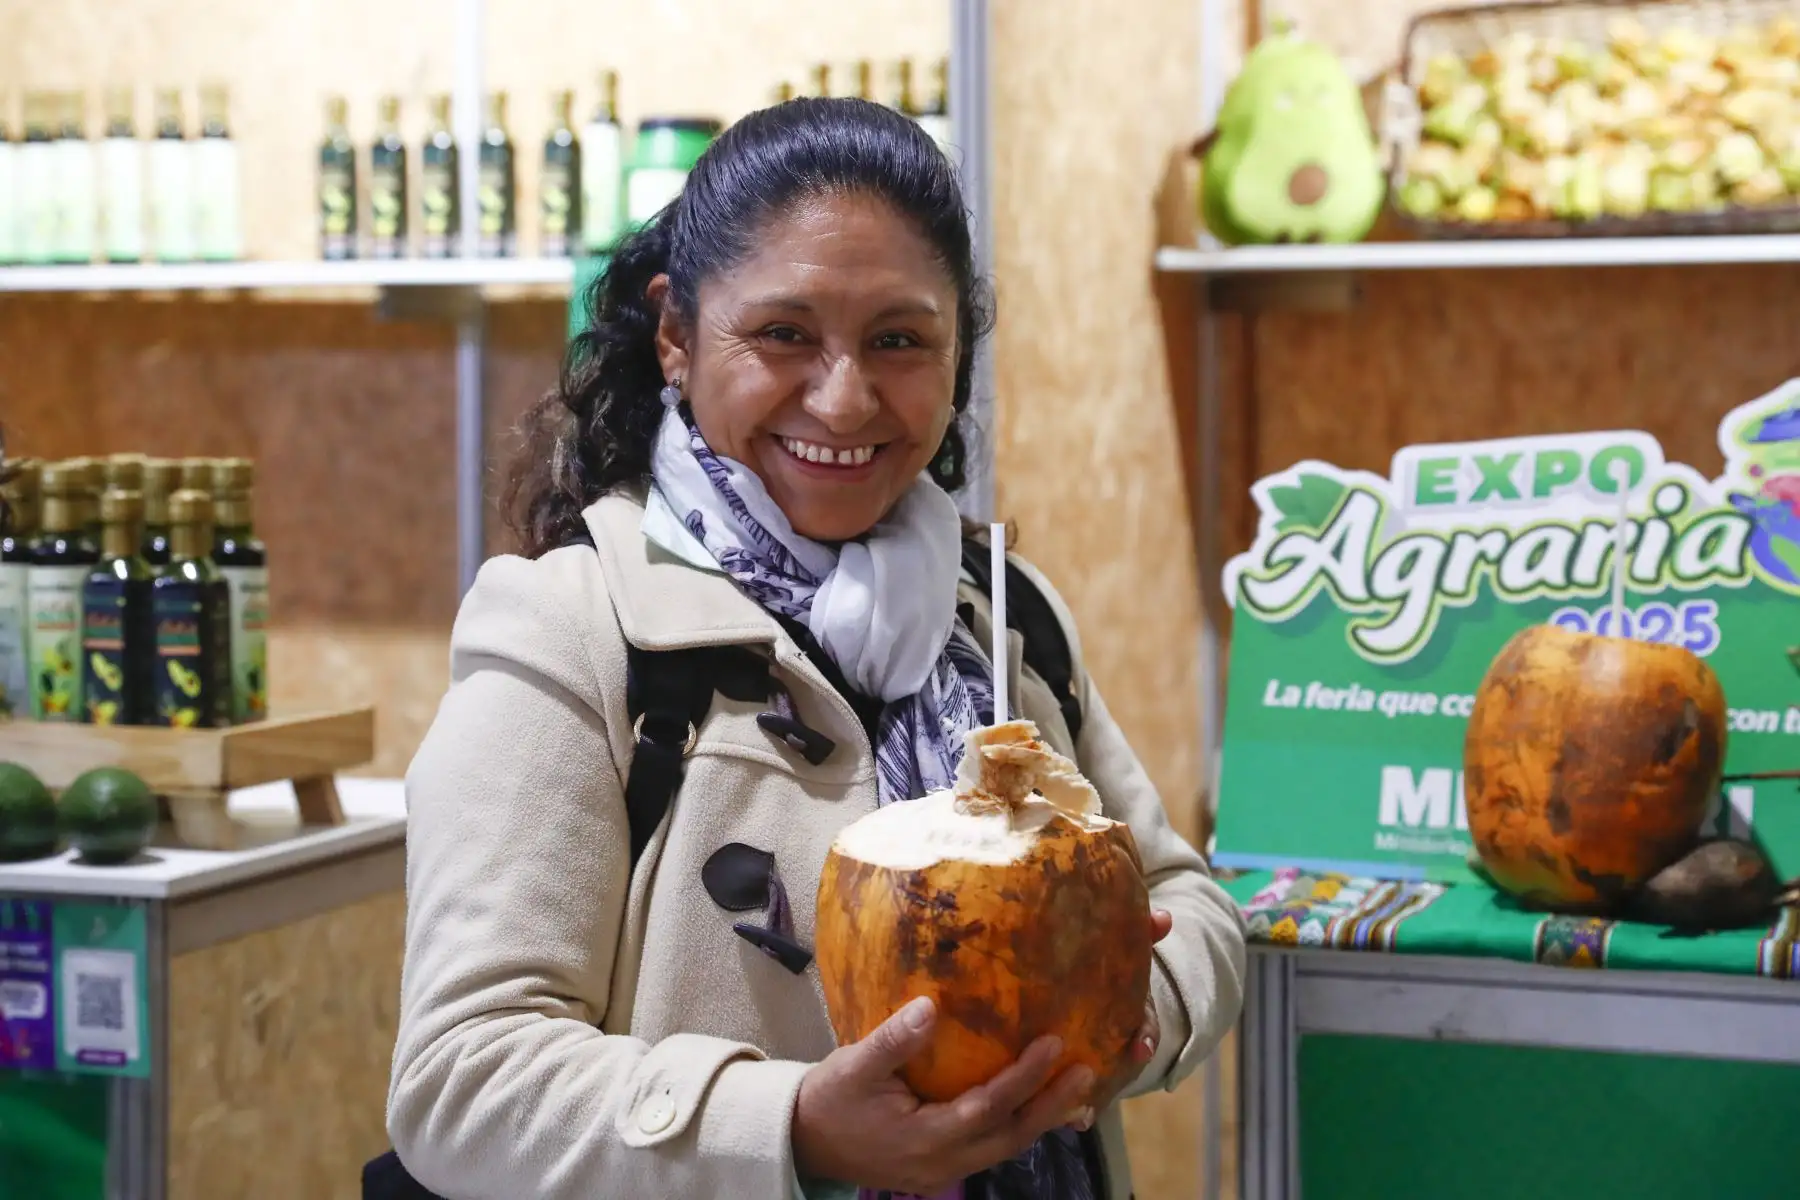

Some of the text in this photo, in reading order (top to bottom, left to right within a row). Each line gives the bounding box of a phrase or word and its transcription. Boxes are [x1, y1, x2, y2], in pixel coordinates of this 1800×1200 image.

[1415, 445, 1645, 505] EXPO
[1240, 482, 1752, 656] Agraria
[1263, 678, 1301, 707] La
[1305, 681, 1375, 711] feria
[1377, 689, 1437, 718] que
